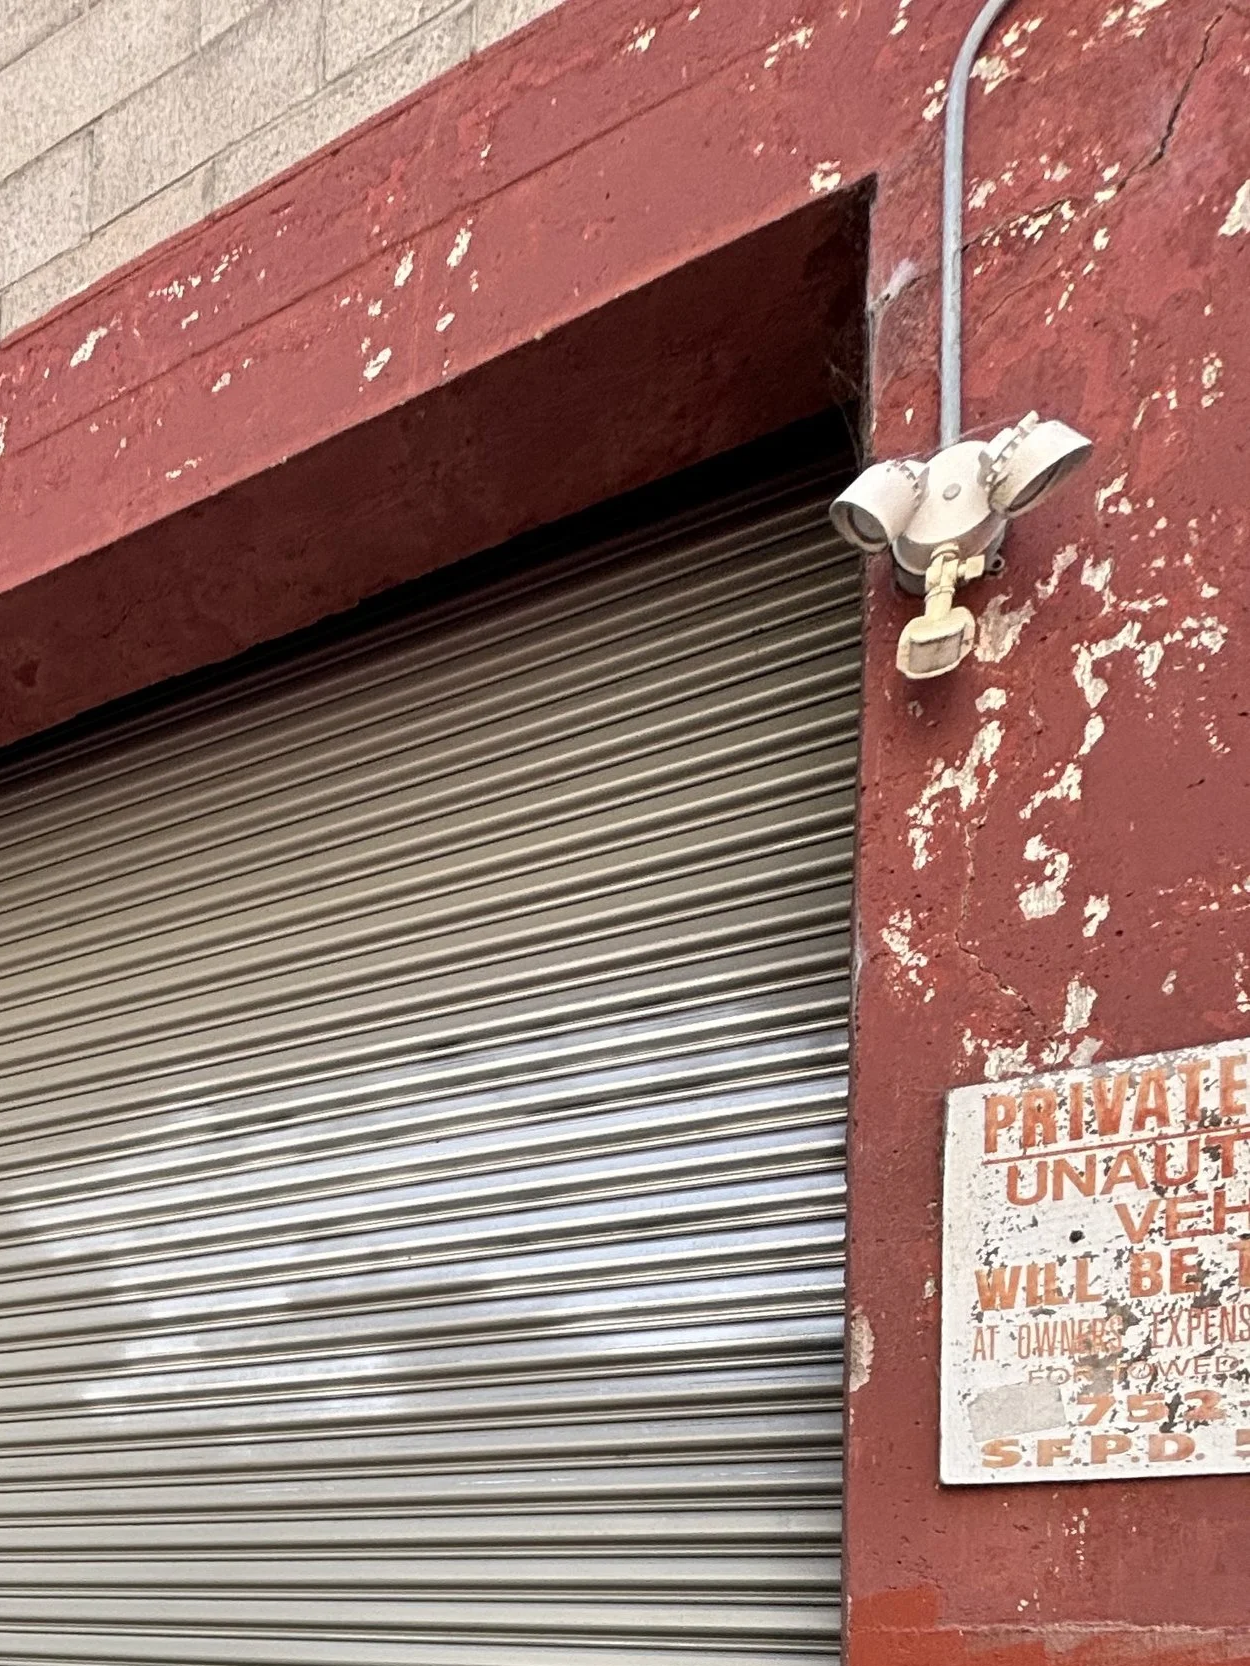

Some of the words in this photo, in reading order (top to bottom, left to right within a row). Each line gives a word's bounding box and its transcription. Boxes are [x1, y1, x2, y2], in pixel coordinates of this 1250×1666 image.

[984, 1054, 1248, 1153] PRIVATE
[1006, 1131, 1250, 1206] UNAUT
[974, 1257, 1102, 1312] WILL
[1129, 1246, 1201, 1299] BE
[972, 1324, 999, 1362] AT
[1017, 1314, 1124, 1360] OWNERS
